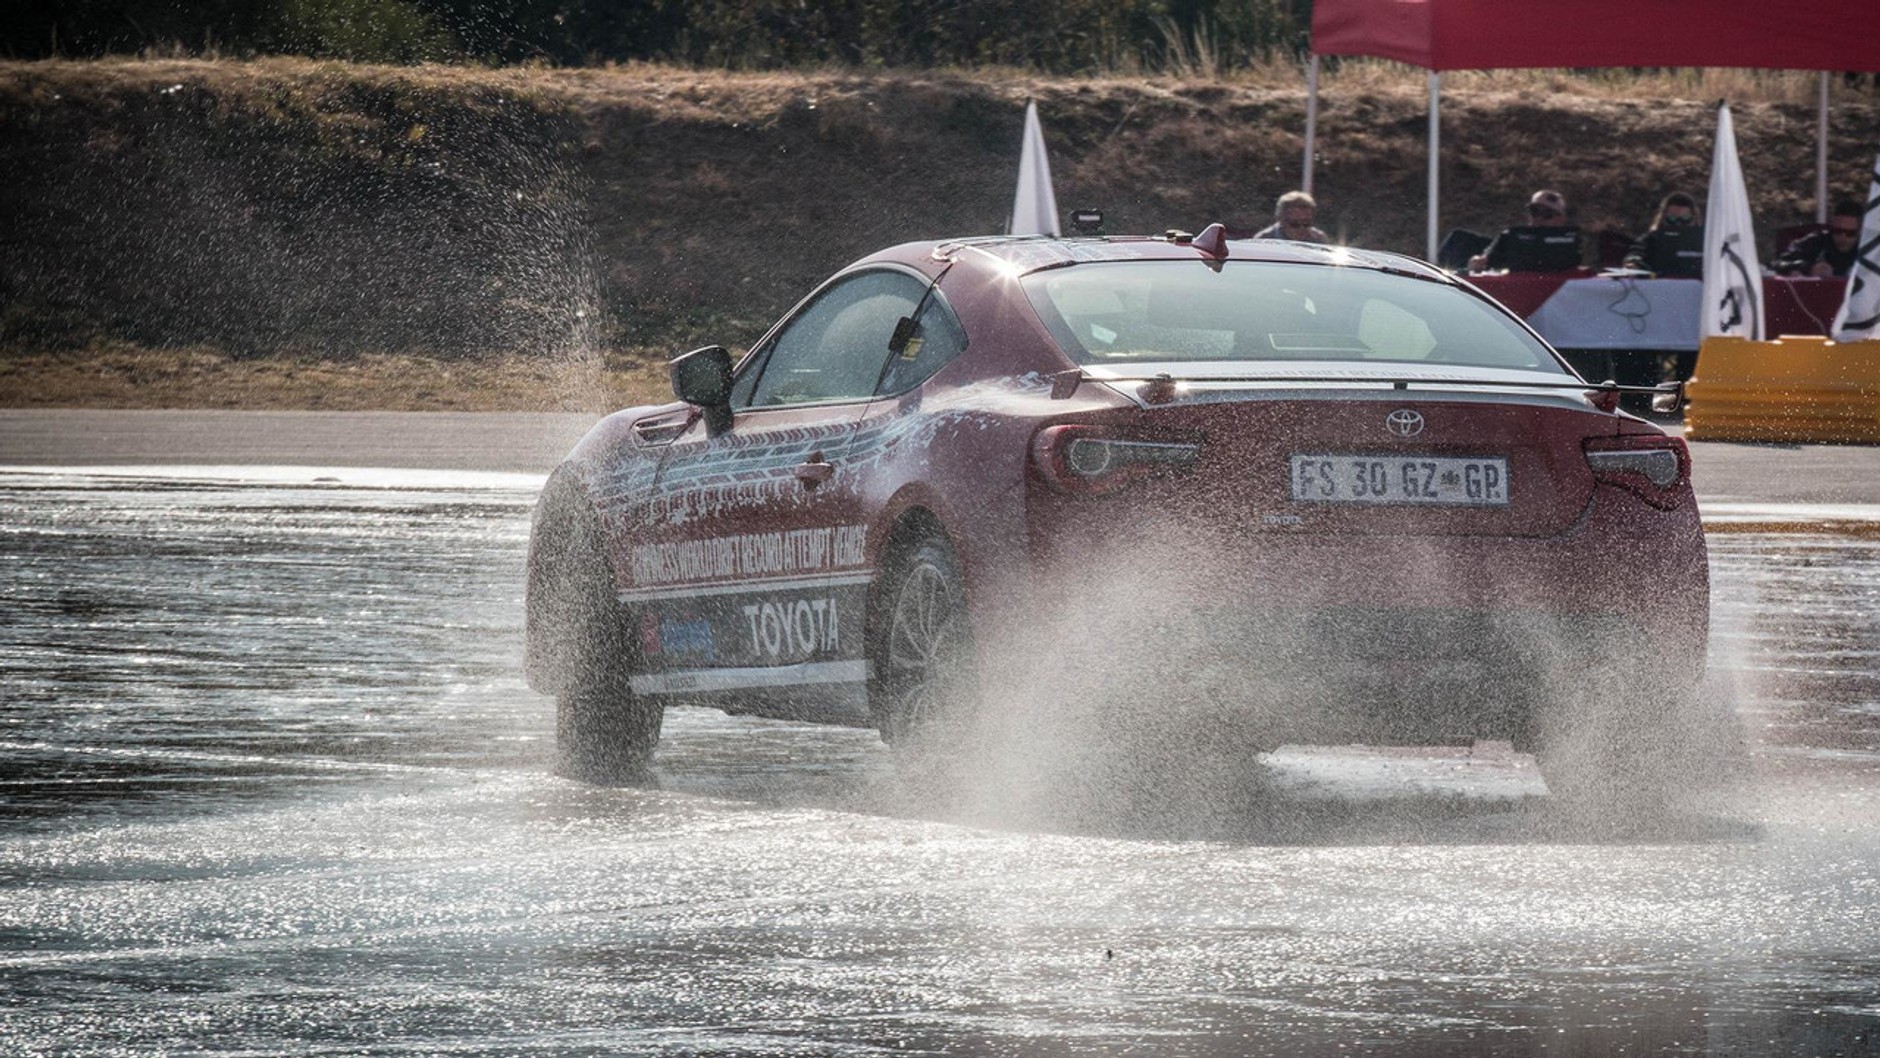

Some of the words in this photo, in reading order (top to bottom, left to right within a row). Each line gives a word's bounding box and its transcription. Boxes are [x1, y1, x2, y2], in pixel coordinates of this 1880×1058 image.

[1300, 460, 1335, 496] FS
[1352, 461, 1388, 497] 30
[1402, 462, 1439, 498] GZ
[1465, 464, 1500, 499] GP
[712, 535, 741, 576] DRIFT
[741, 532, 783, 574] RECORD
[784, 527, 832, 570] ATTEMPT
[744, 598, 839, 658] TOYOTA
